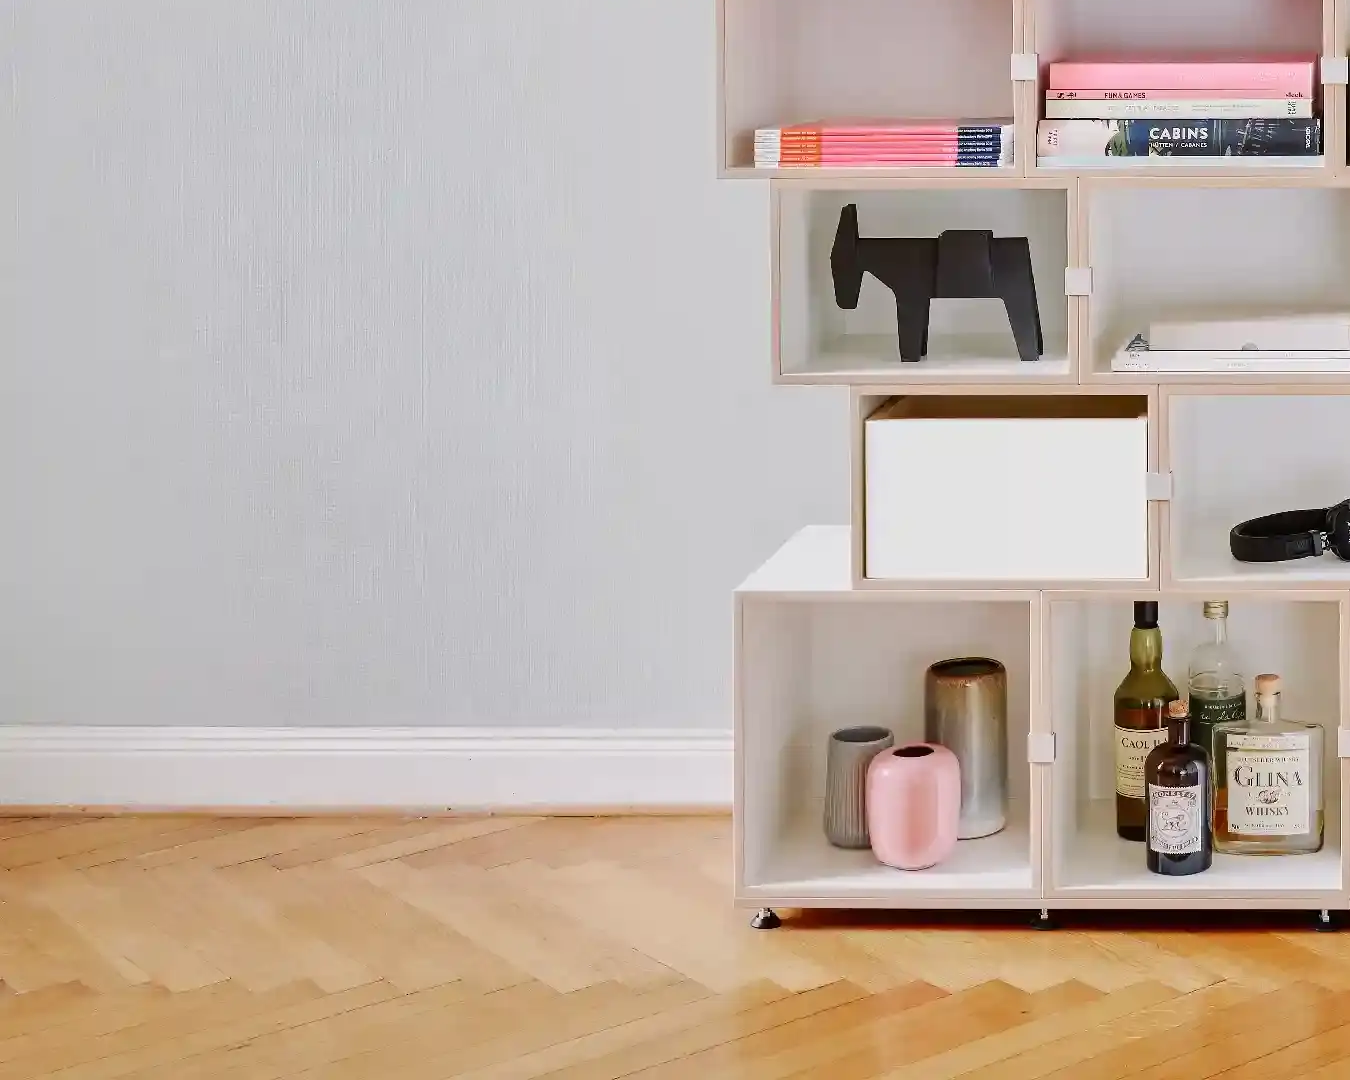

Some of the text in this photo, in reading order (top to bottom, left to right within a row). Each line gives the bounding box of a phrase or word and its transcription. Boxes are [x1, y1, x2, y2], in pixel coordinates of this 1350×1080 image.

[1149, 127, 1209, 140] CABINS
[1121, 737, 1150, 749] CAOL
[1234, 766, 1303, 787] GLINA
[1246, 806, 1289, 816] WHISKY
